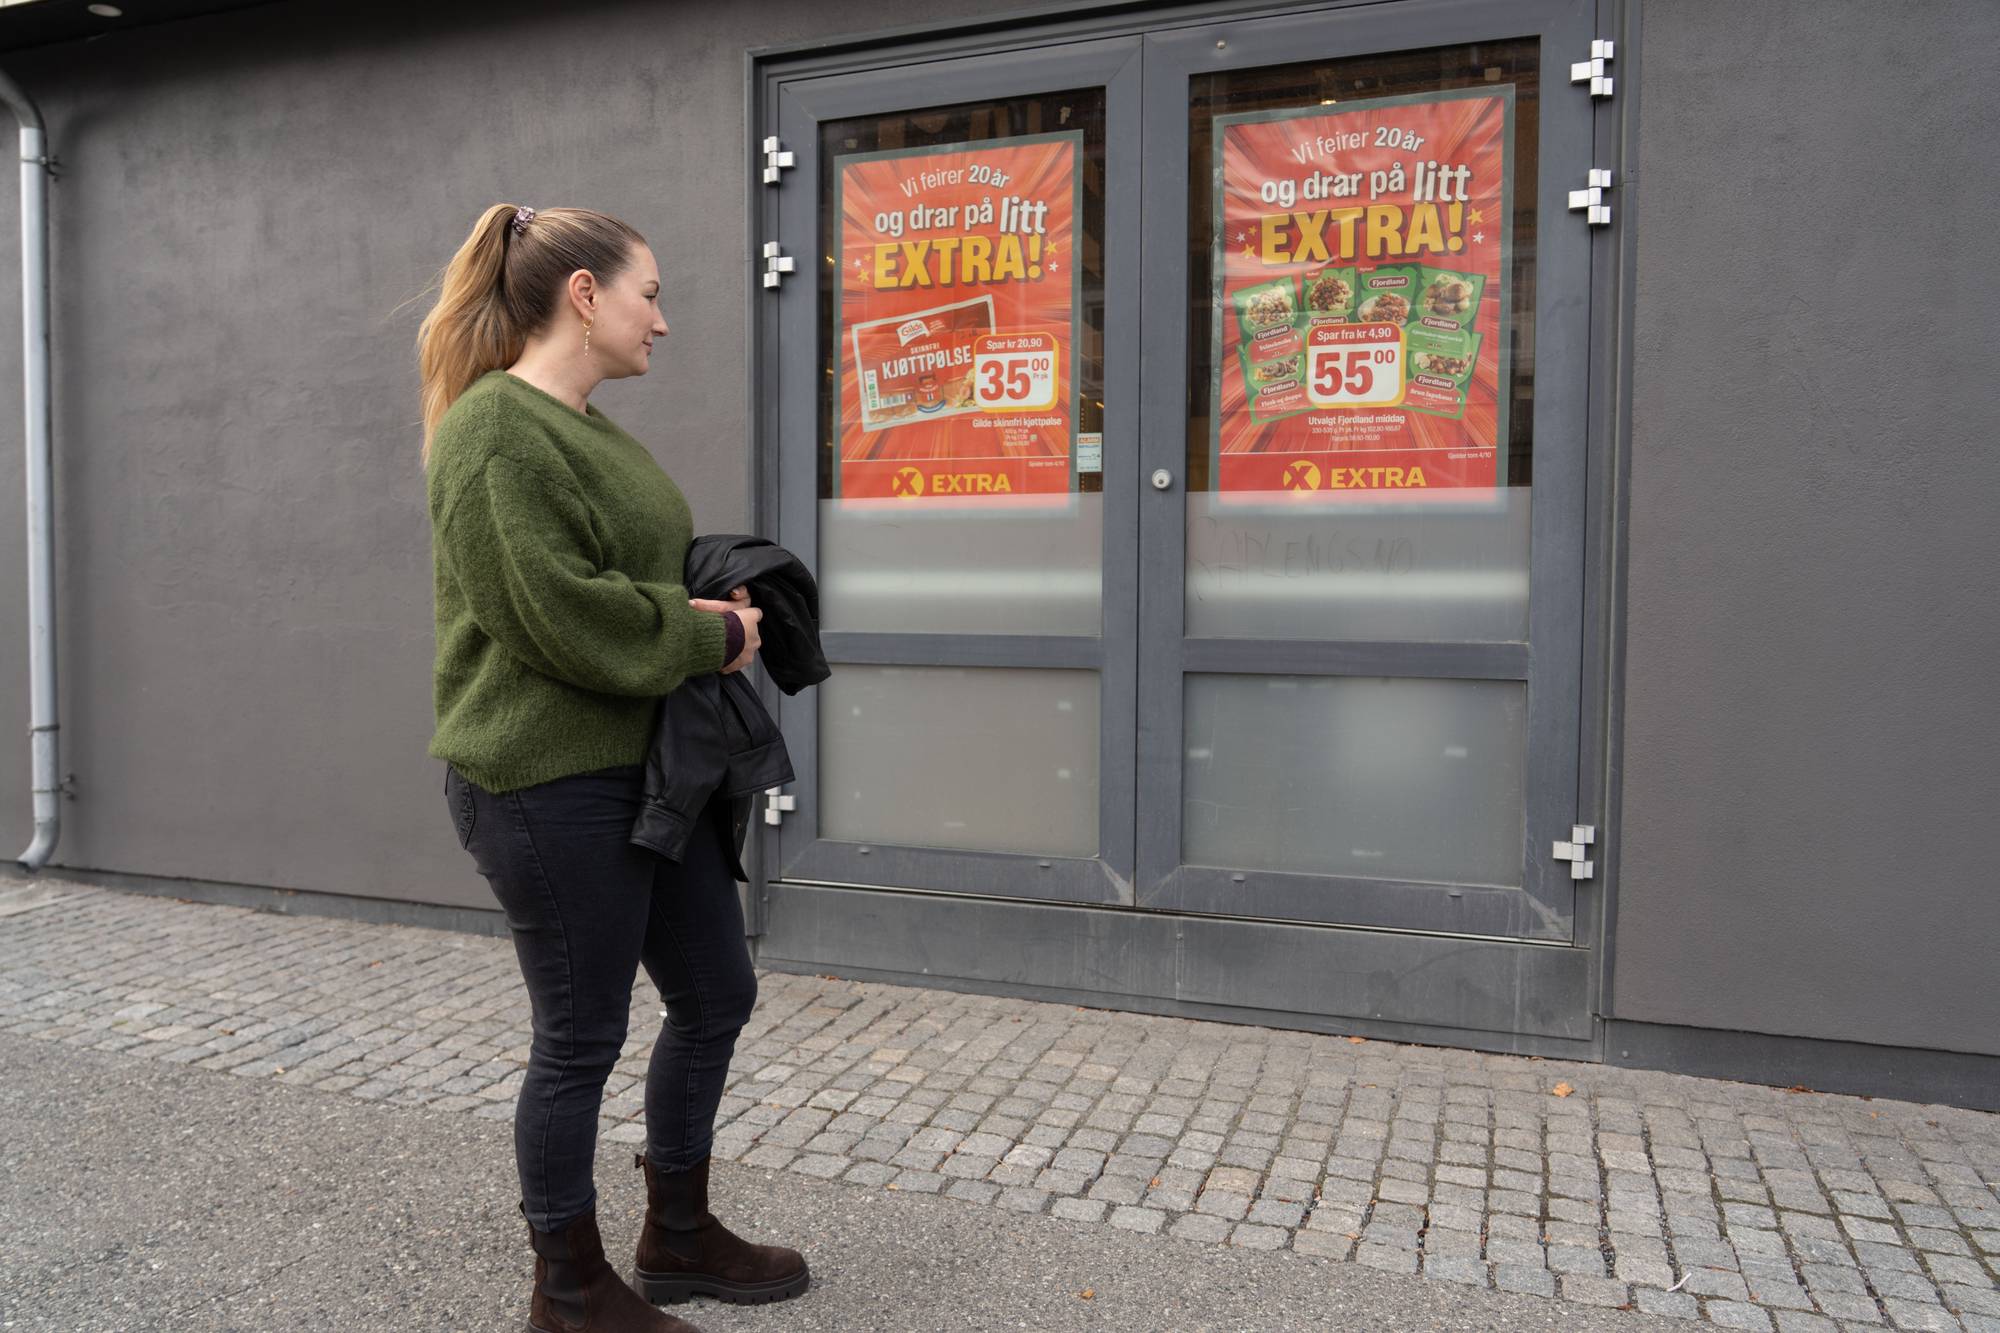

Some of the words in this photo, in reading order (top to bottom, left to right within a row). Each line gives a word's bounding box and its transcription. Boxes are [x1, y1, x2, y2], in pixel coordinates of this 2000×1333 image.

[1292, 143, 1314, 165] Vi
[1316, 130, 1369, 156] feirer
[900, 180, 917, 198] Vi
[920, 168, 964, 190] feirer
[1261, 179, 1296, 208] og
[1303, 171, 1363, 199] drar
[1370, 162, 1405, 200] på
[1413, 160, 1471, 202] litt
[875, 210, 904, 237] og
[909, 203, 959, 231] drar
[965, 197, 993, 231] på
[1000, 196, 1048, 234] litt
[1261, 201, 1466, 265] EXTRA!
[873, 233, 1045, 289] EXTRA!
[1372, 278, 1406, 288] Fjordland
[1313, 317, 1344, 326] Fjordland
[1424, 319, 1457, 329] Fjordland
[1257, 326, 1288, 339] Fjordland
[1317, 331, 1339, 342] Spar
[1341, 329, 1355, 339] fra
[1356, 329, 1367, 339] kr
[1368, 327, 1392, 339] 4,90
[986, 340, 1006, 351] Spar
[1007, 339, 1016, 349] kr
[1017, 338, 1042, 350] 20,90
[882, 344, 973, 379] KJØTTPØLSE
[980, 359, 1031, 401] 35
[1032, 358, 1049, 371] 00
[1314, 351, 1373, 396] 55
[1374, 349, 1395, 364] 00
[1418, 375, 1452, 388] Fjordland
[1263, 382, 1295, 394] Fjordland
[972, 419, 993, 428] Gilde
[1308, 416, 1336, 426] Utvalgt
[1338, 415, 1374, 426] Fjordland
[1375, 414, 1405, 425] middag
[932, 473, 1012, 493] EXTRA
[1330, 466, 1427, 488] EXTRA
